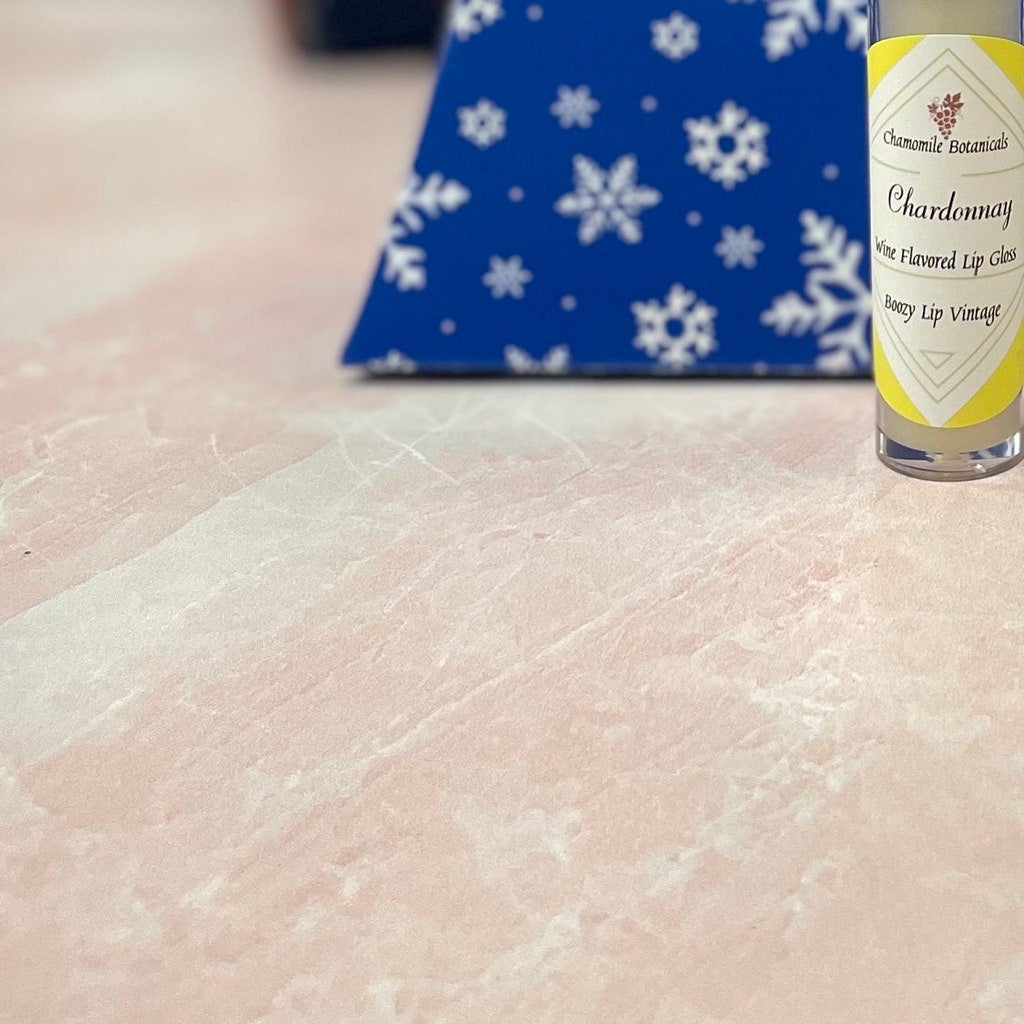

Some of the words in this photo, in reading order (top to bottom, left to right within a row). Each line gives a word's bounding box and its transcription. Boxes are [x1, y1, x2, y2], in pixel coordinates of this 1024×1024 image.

[883, 128, 943, 154] Chamomile
[949, 131, 1009, 154] Botanicals
[888, 183, 1013, 231] Chardonnay
[875, 236, 896, 261] Wine
[900, 246, 957, 270] Flavored
[962, 251, 984, 276] Lip
[989, 244, 1017, 267] Gloss
[884, 293, 916, 324] Boozy
[921, 302, 944, 328] Lip
[950, 303, 1002, 327] Vintage
